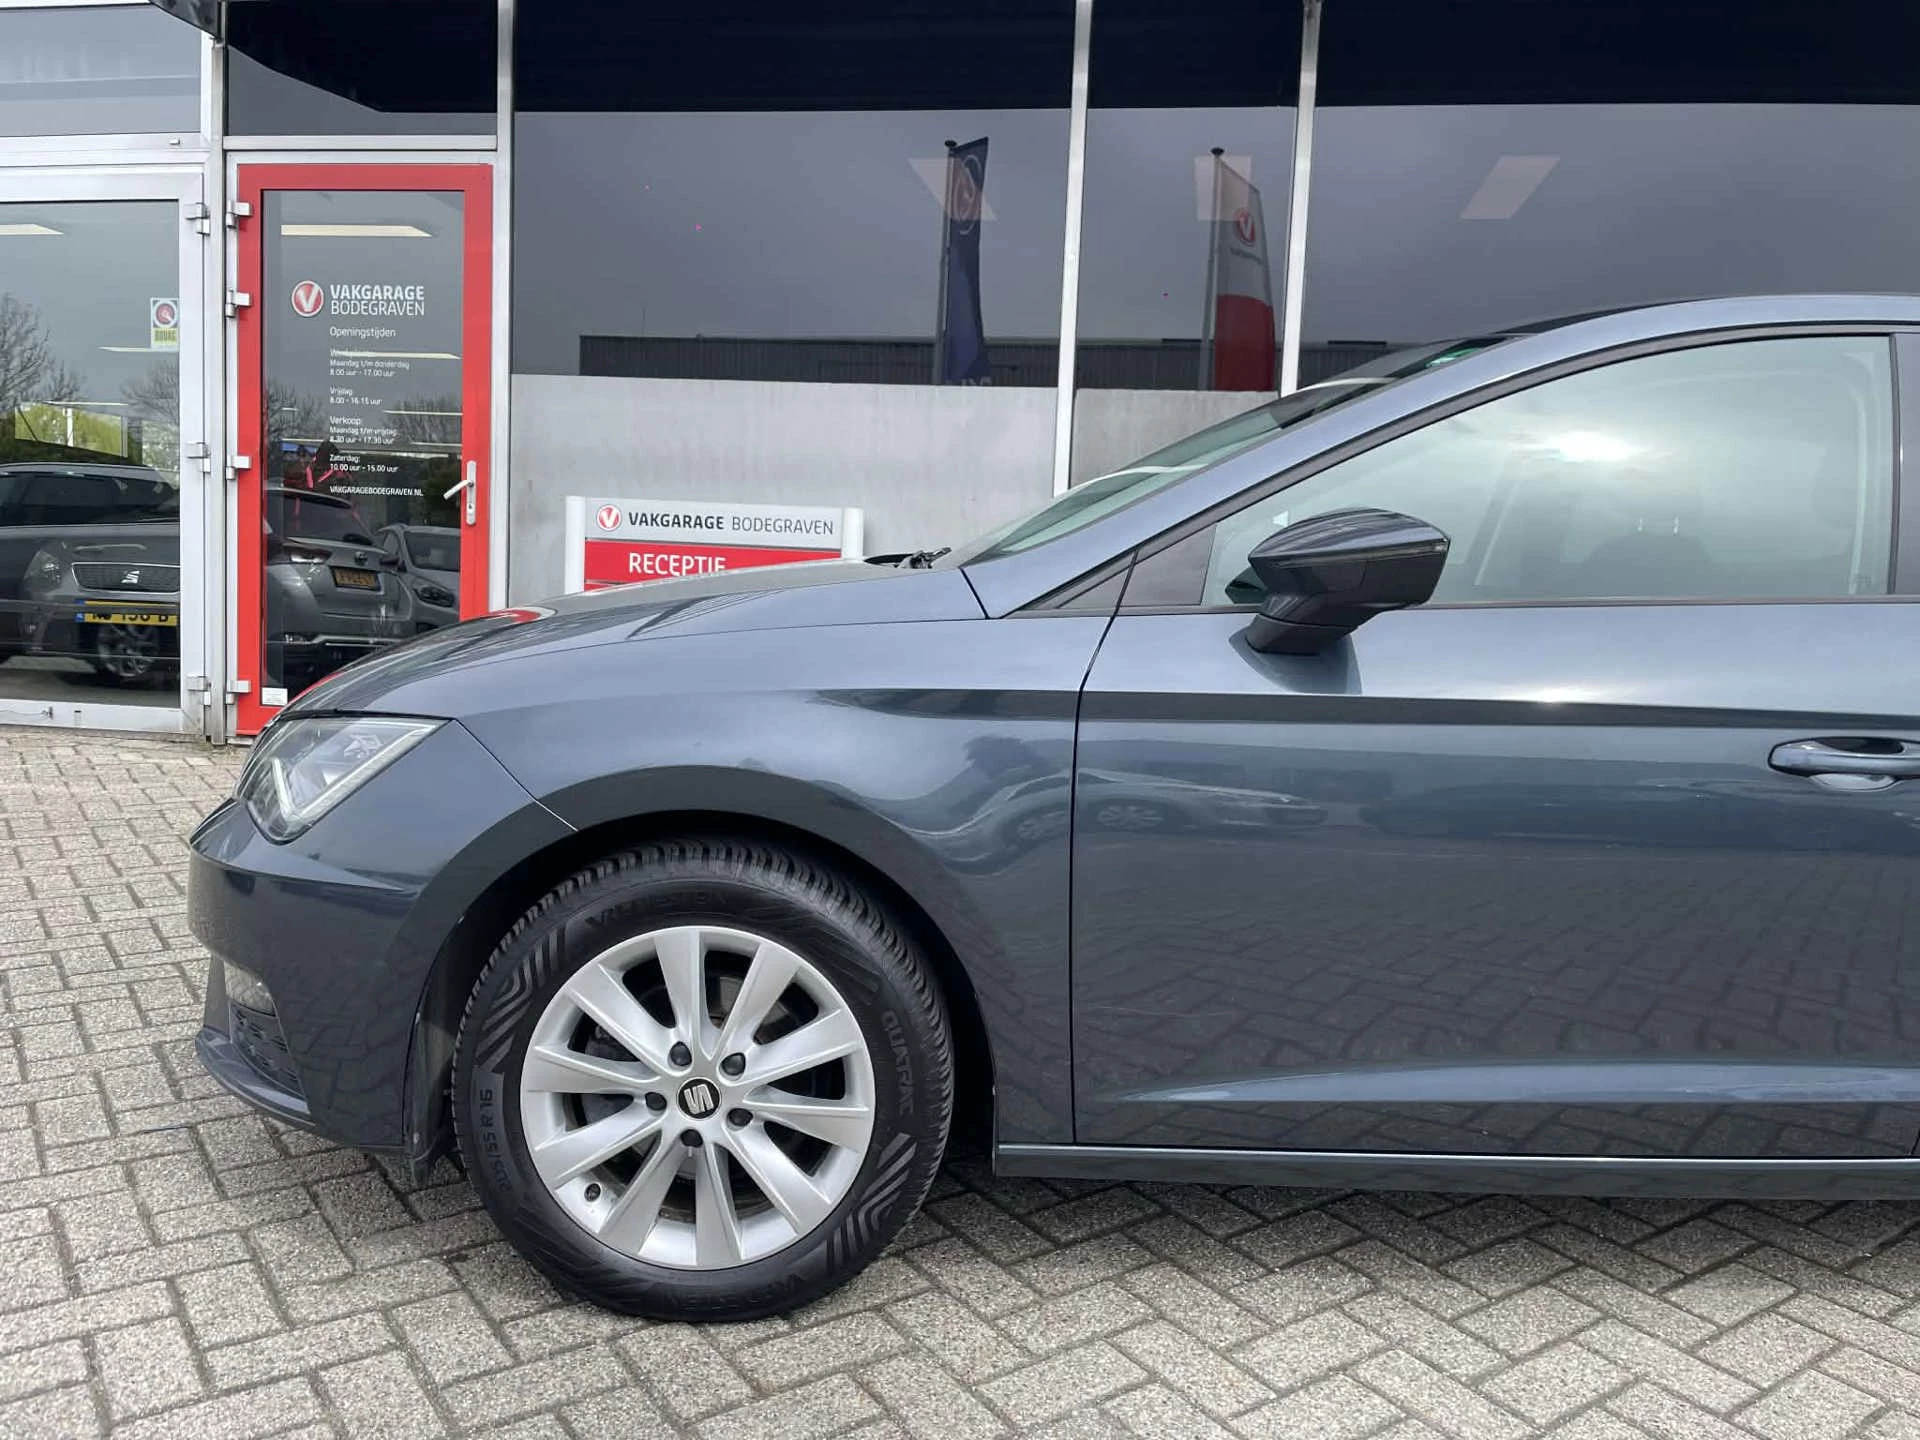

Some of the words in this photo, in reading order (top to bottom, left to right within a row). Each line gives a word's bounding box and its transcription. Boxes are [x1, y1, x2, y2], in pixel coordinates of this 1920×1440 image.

[330, 284, 425, 300] VAKGARAGE
[331, 301, 425, 316] BODEGRAVEN
[330, 326, 396, 339] Openingstijden
[330, 454, 361, 463] Zaterdag:
[330, 463, 349, 471] 10.00
[387, 465, 399, 473] uur
[628, 511, 725, 531] VAKGARAGE
[731, 516, 834, 536] BODEGRAVEN
